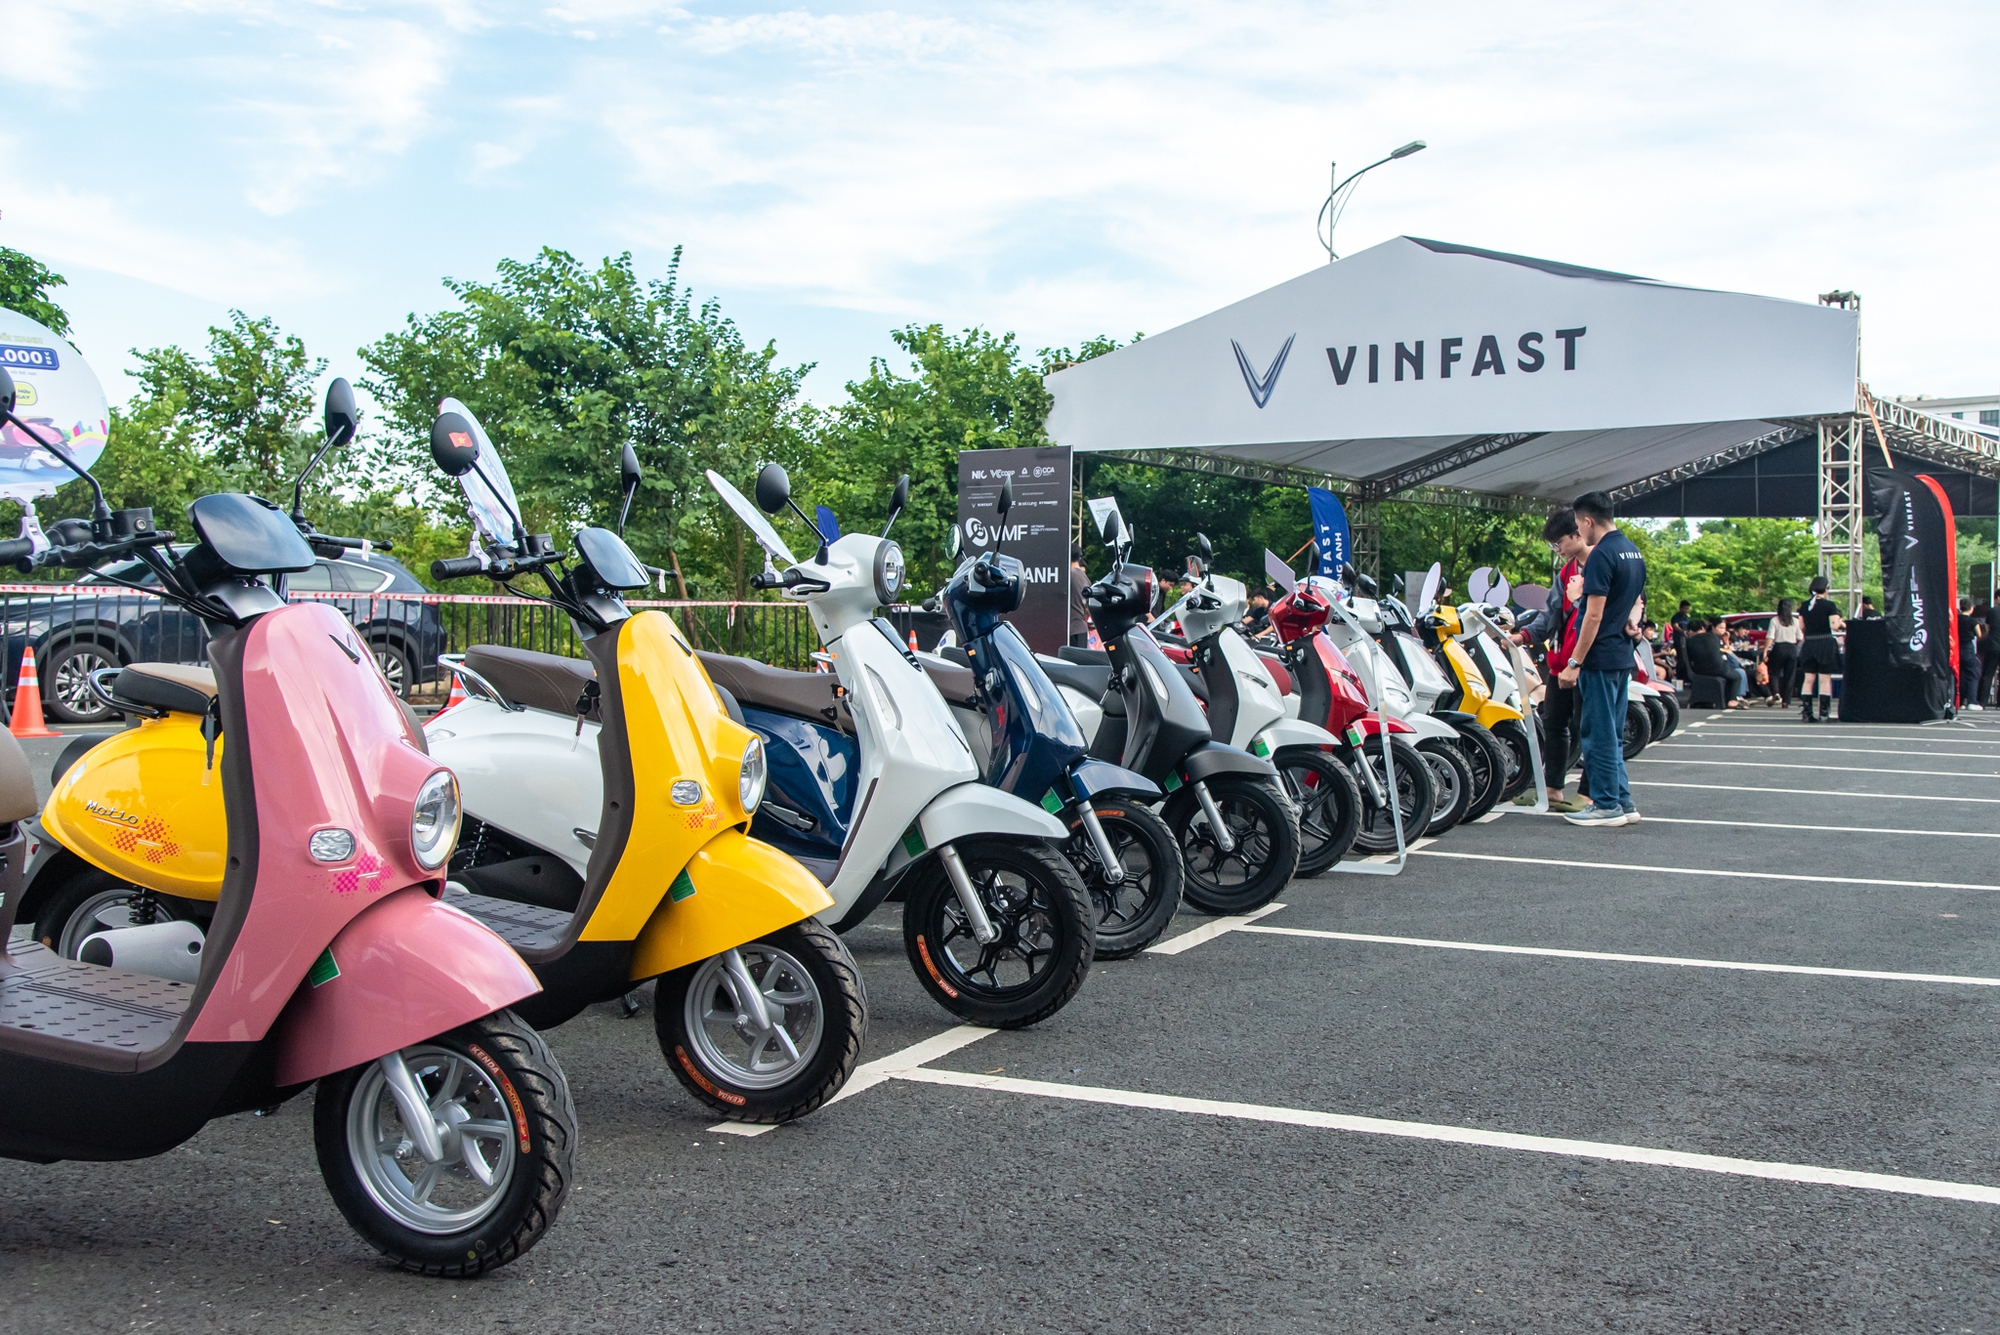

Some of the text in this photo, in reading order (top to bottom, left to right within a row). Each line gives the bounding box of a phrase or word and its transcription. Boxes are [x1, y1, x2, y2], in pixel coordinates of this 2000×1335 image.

[1326, 326, 1587, 386] VINFAST
[972, 470, 987, 479] NIC
[1903, 490, 1914, 531] VINFAST
[990, 525, 1028, 541] VMF
[1335, 532, 1343, 561] ANH
[1025, 567, 1058, 583] ANH
[1911, 593, 1924, 628] VMF
[471, 1046, 499, 1073] KENDA
[718, 1090, 744, 1104] KENDA
